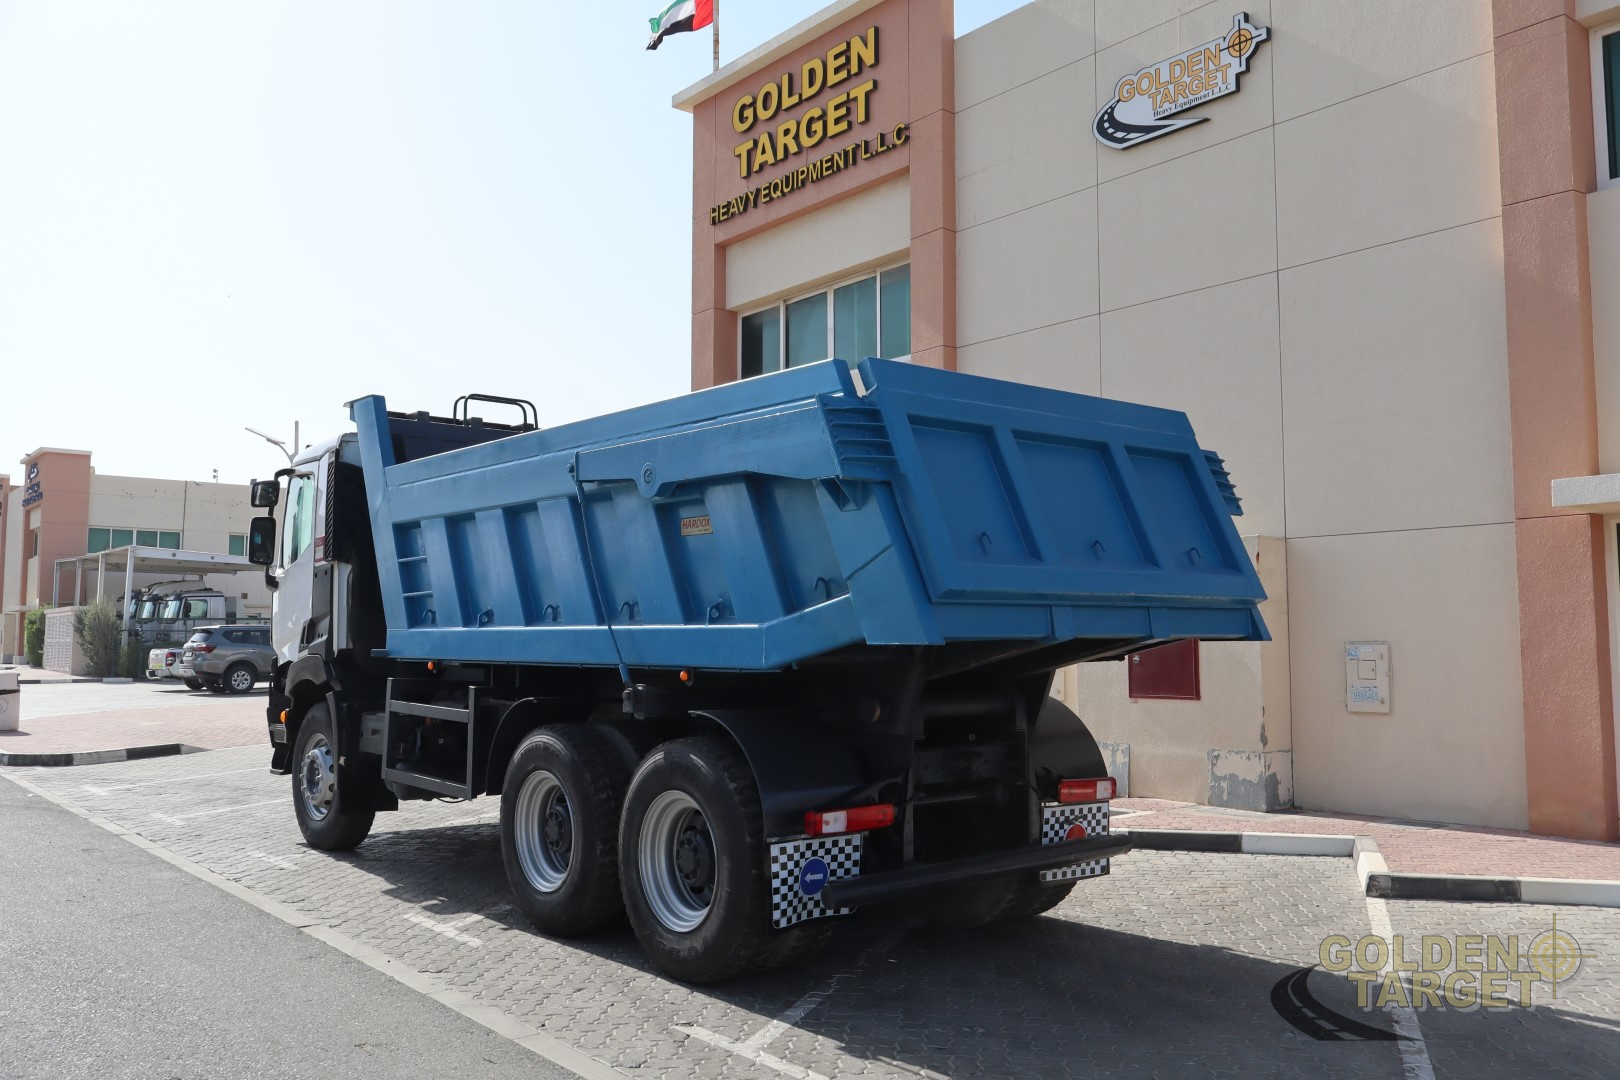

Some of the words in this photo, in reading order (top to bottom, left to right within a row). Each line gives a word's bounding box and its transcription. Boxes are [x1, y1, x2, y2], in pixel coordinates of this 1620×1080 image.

[732, 26, 879, 133] GOLDEN
[1118, 43, 1221, 102] GOLDEN
[1148, 63, 1231, 111] TARGET
[1153, 106, 1172, 118] Heavy
[1174, 92, 1210, 110] Equipment
[734, 79, 877, 179] TARGET
[710, 189, 761, 225] HEAVY
[761, 143, 863, 204] EQUIPMENT
[861, 122, 910, 160] L.L.C
